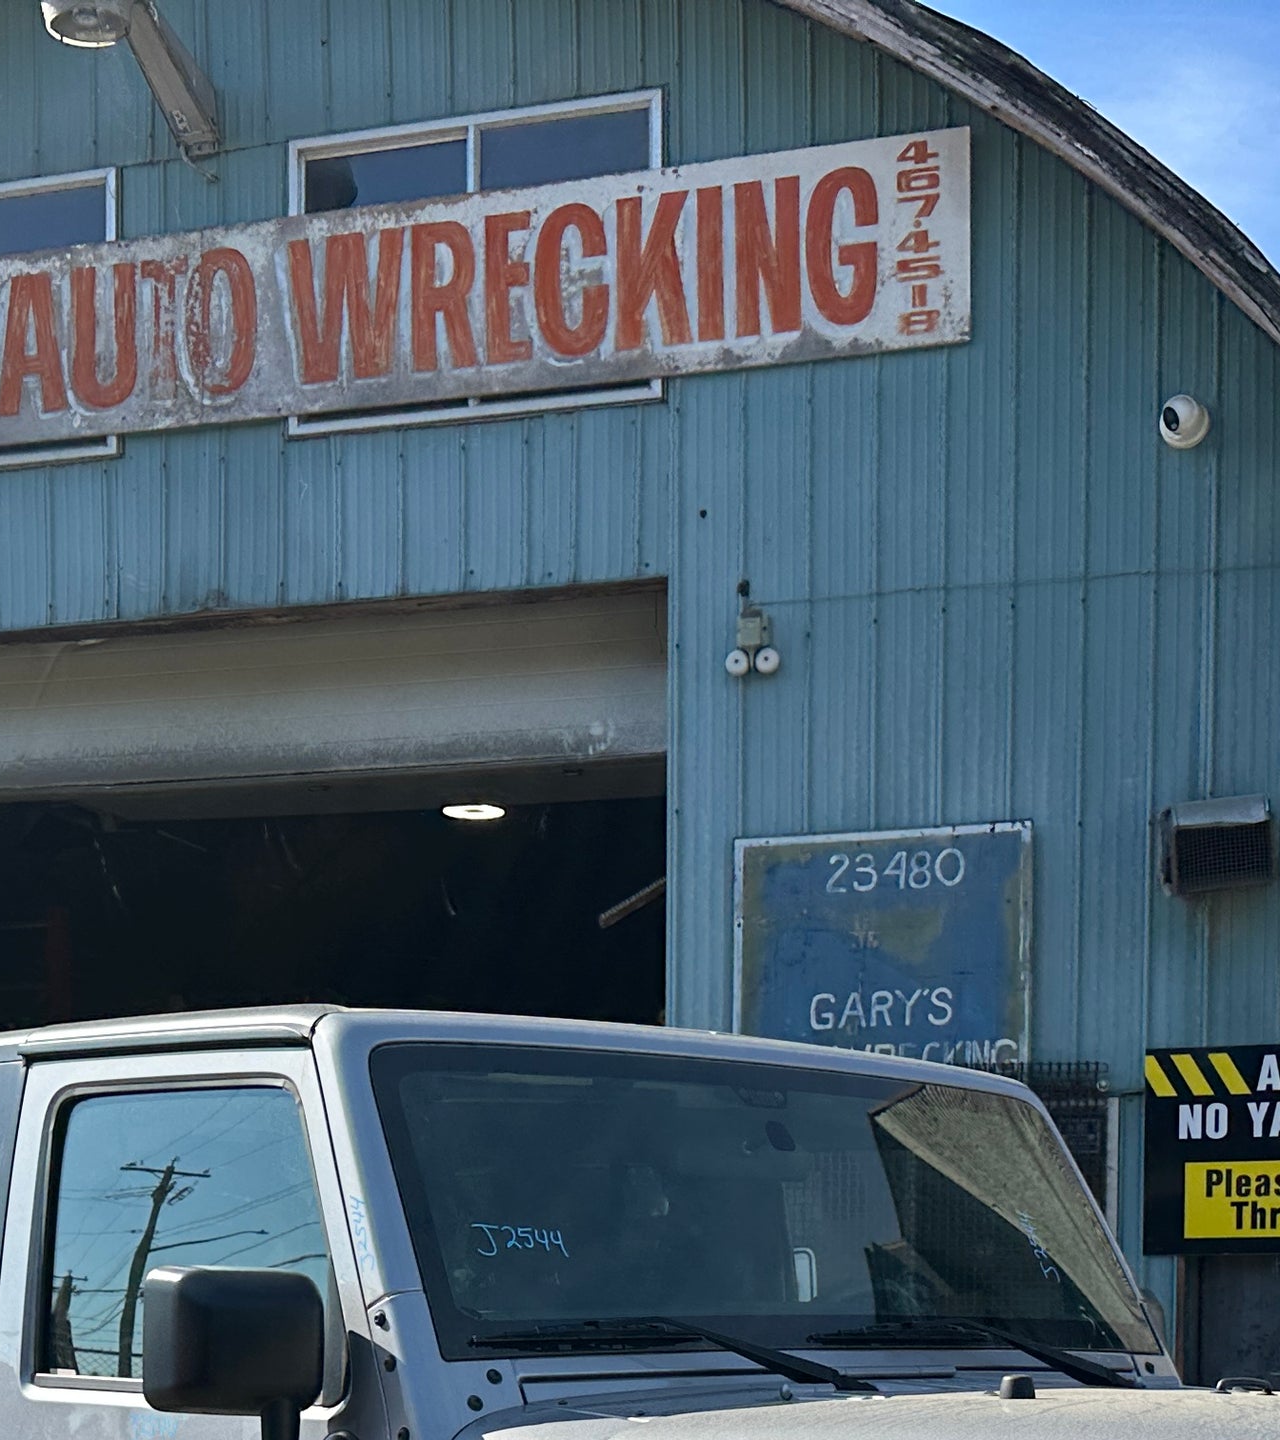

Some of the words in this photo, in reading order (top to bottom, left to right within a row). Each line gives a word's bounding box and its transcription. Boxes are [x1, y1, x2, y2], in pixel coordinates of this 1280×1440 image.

[287, 166, 880, 386] WRECKING
[825, 847, 966, 893] 23480
[809, 987, 953, 1031] GARY'S
[1178, 1103, 1229, 1140] NO
[471, 1223, 570, 1258] J2544
